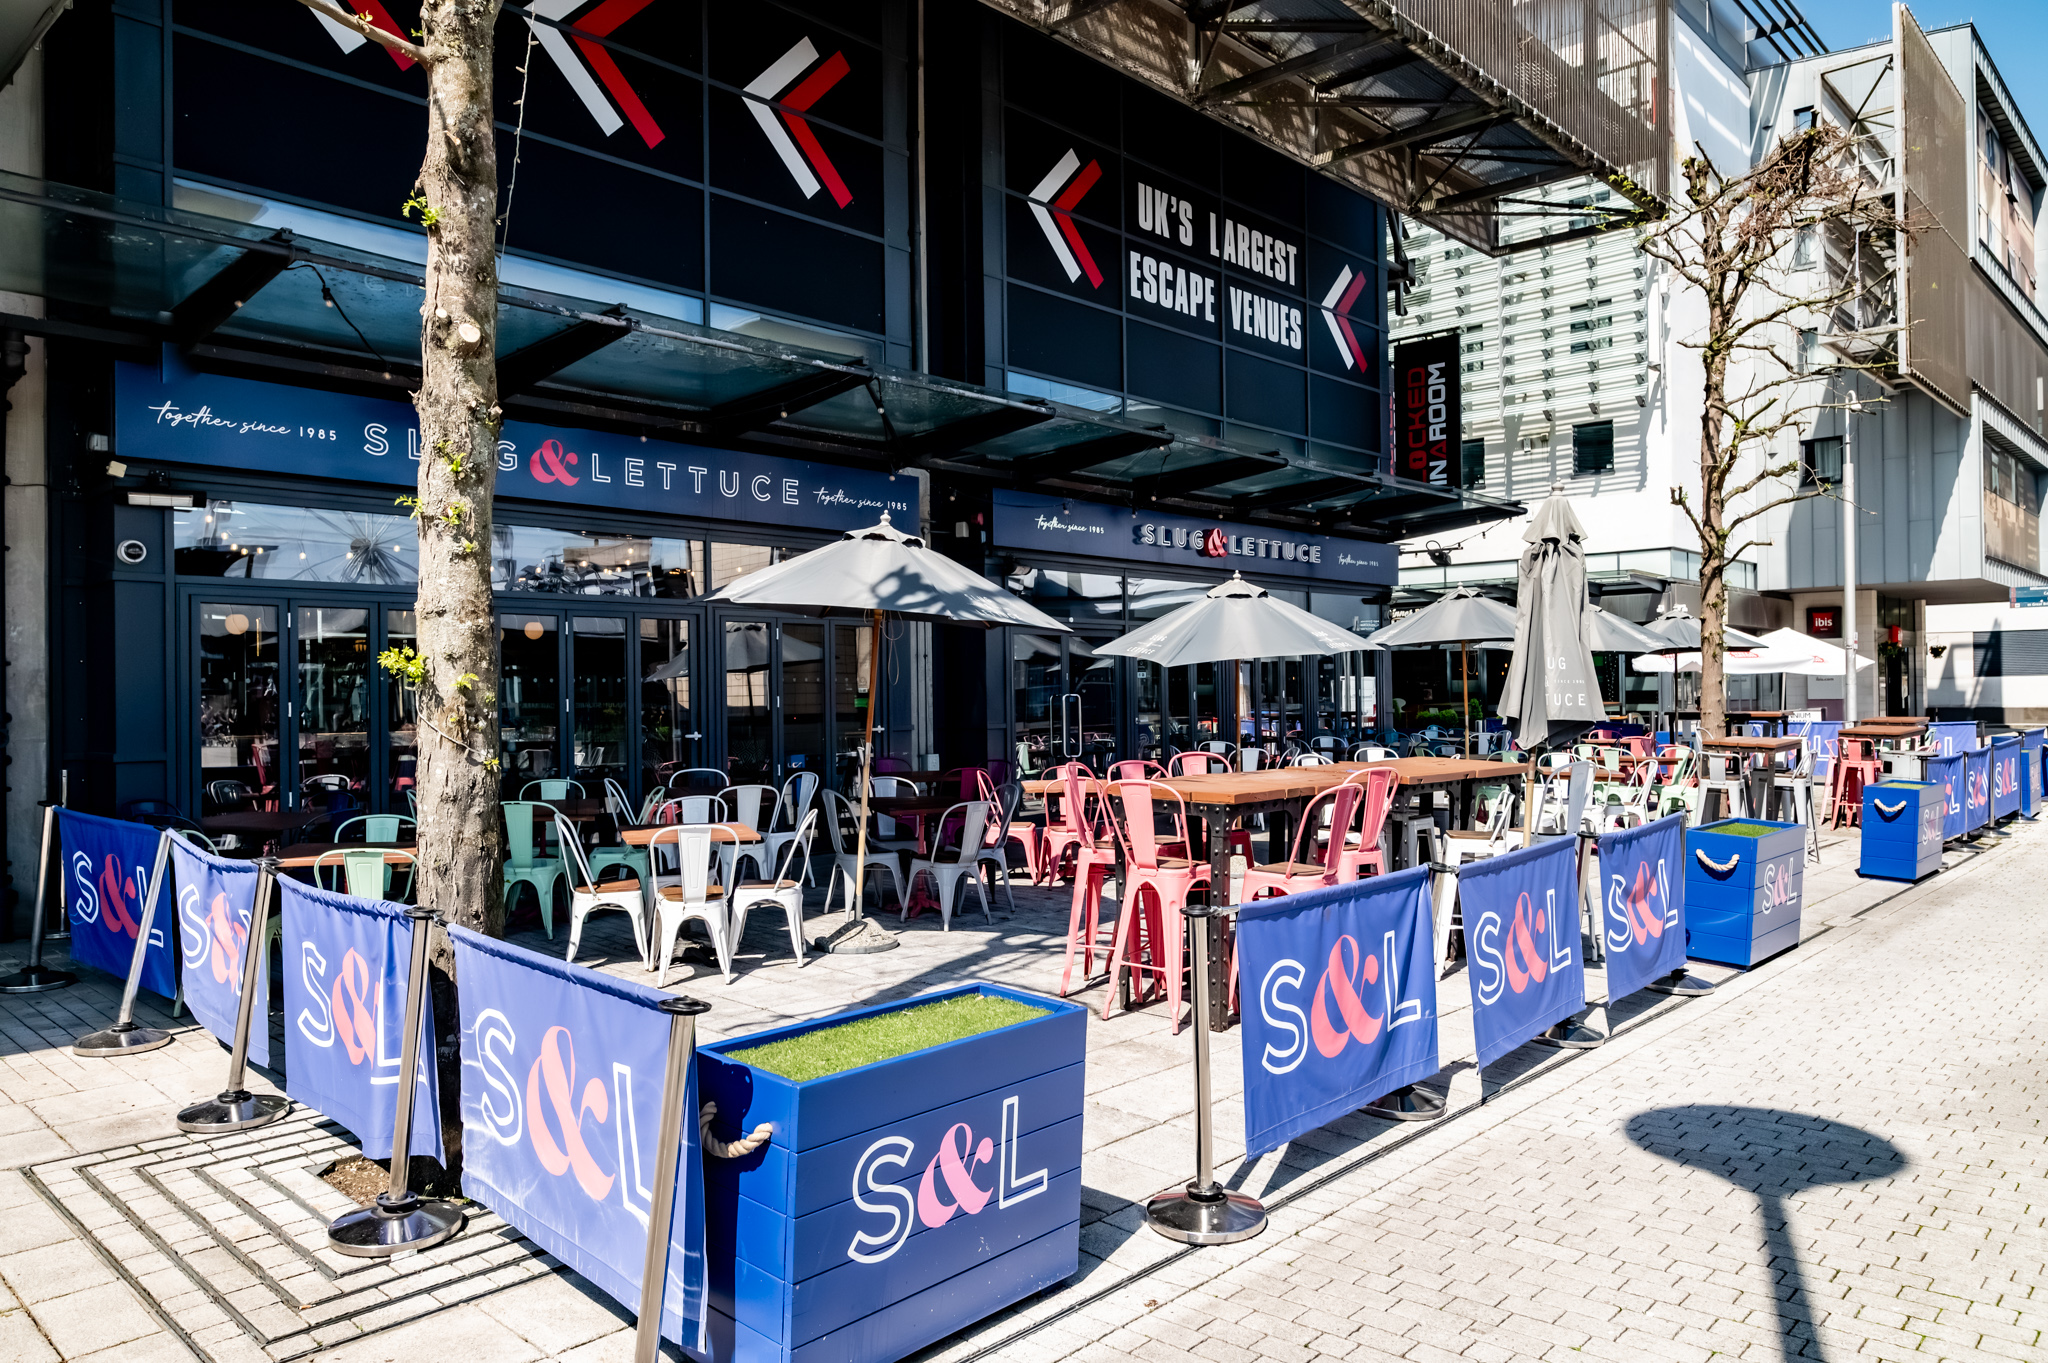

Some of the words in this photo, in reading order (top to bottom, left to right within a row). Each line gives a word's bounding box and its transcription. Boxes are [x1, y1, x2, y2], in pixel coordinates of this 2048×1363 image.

[1138, 182, 1193, 247] UK'S
[1210, 212, 1297, 287] LARGEST
[1130, 251, 1215, 323] ESCAPE
[1230, 286, 1302, 350] VENUES
[148, 401, 237, 428] together
[239, 421, 291, 434] since
[300, 426, 337, 441] 1985
[364, 423, 518, 471] SLG
[529, 439, 580, 487] &
[592, 453, 799, 505] LETTUCE
[813, 487, 857, 504] together
[856, 497, 883, 509] since
[887, 501, 907, 511] 1985
[1035, 514, 1067, 530] together
[1067, 524, 1087, 532] since
[1089, 526, 1104, 534] 1985
[1143, 524, 1204, 550] SLUG
[1230, 535, 1321, 564] LETTUCE
[1815, 617, 1833, 627] ibis
[1922, 806, 1941, 845] S&L
[1607, 858, 1679, 953] S&L
[1762, 857, 1798, 914] S&L
[1473, 889, 1572, 1006] S&L
[1260, 930, 1422, 1075] S&L
[847, 1095, 1048, 1264] S&L
